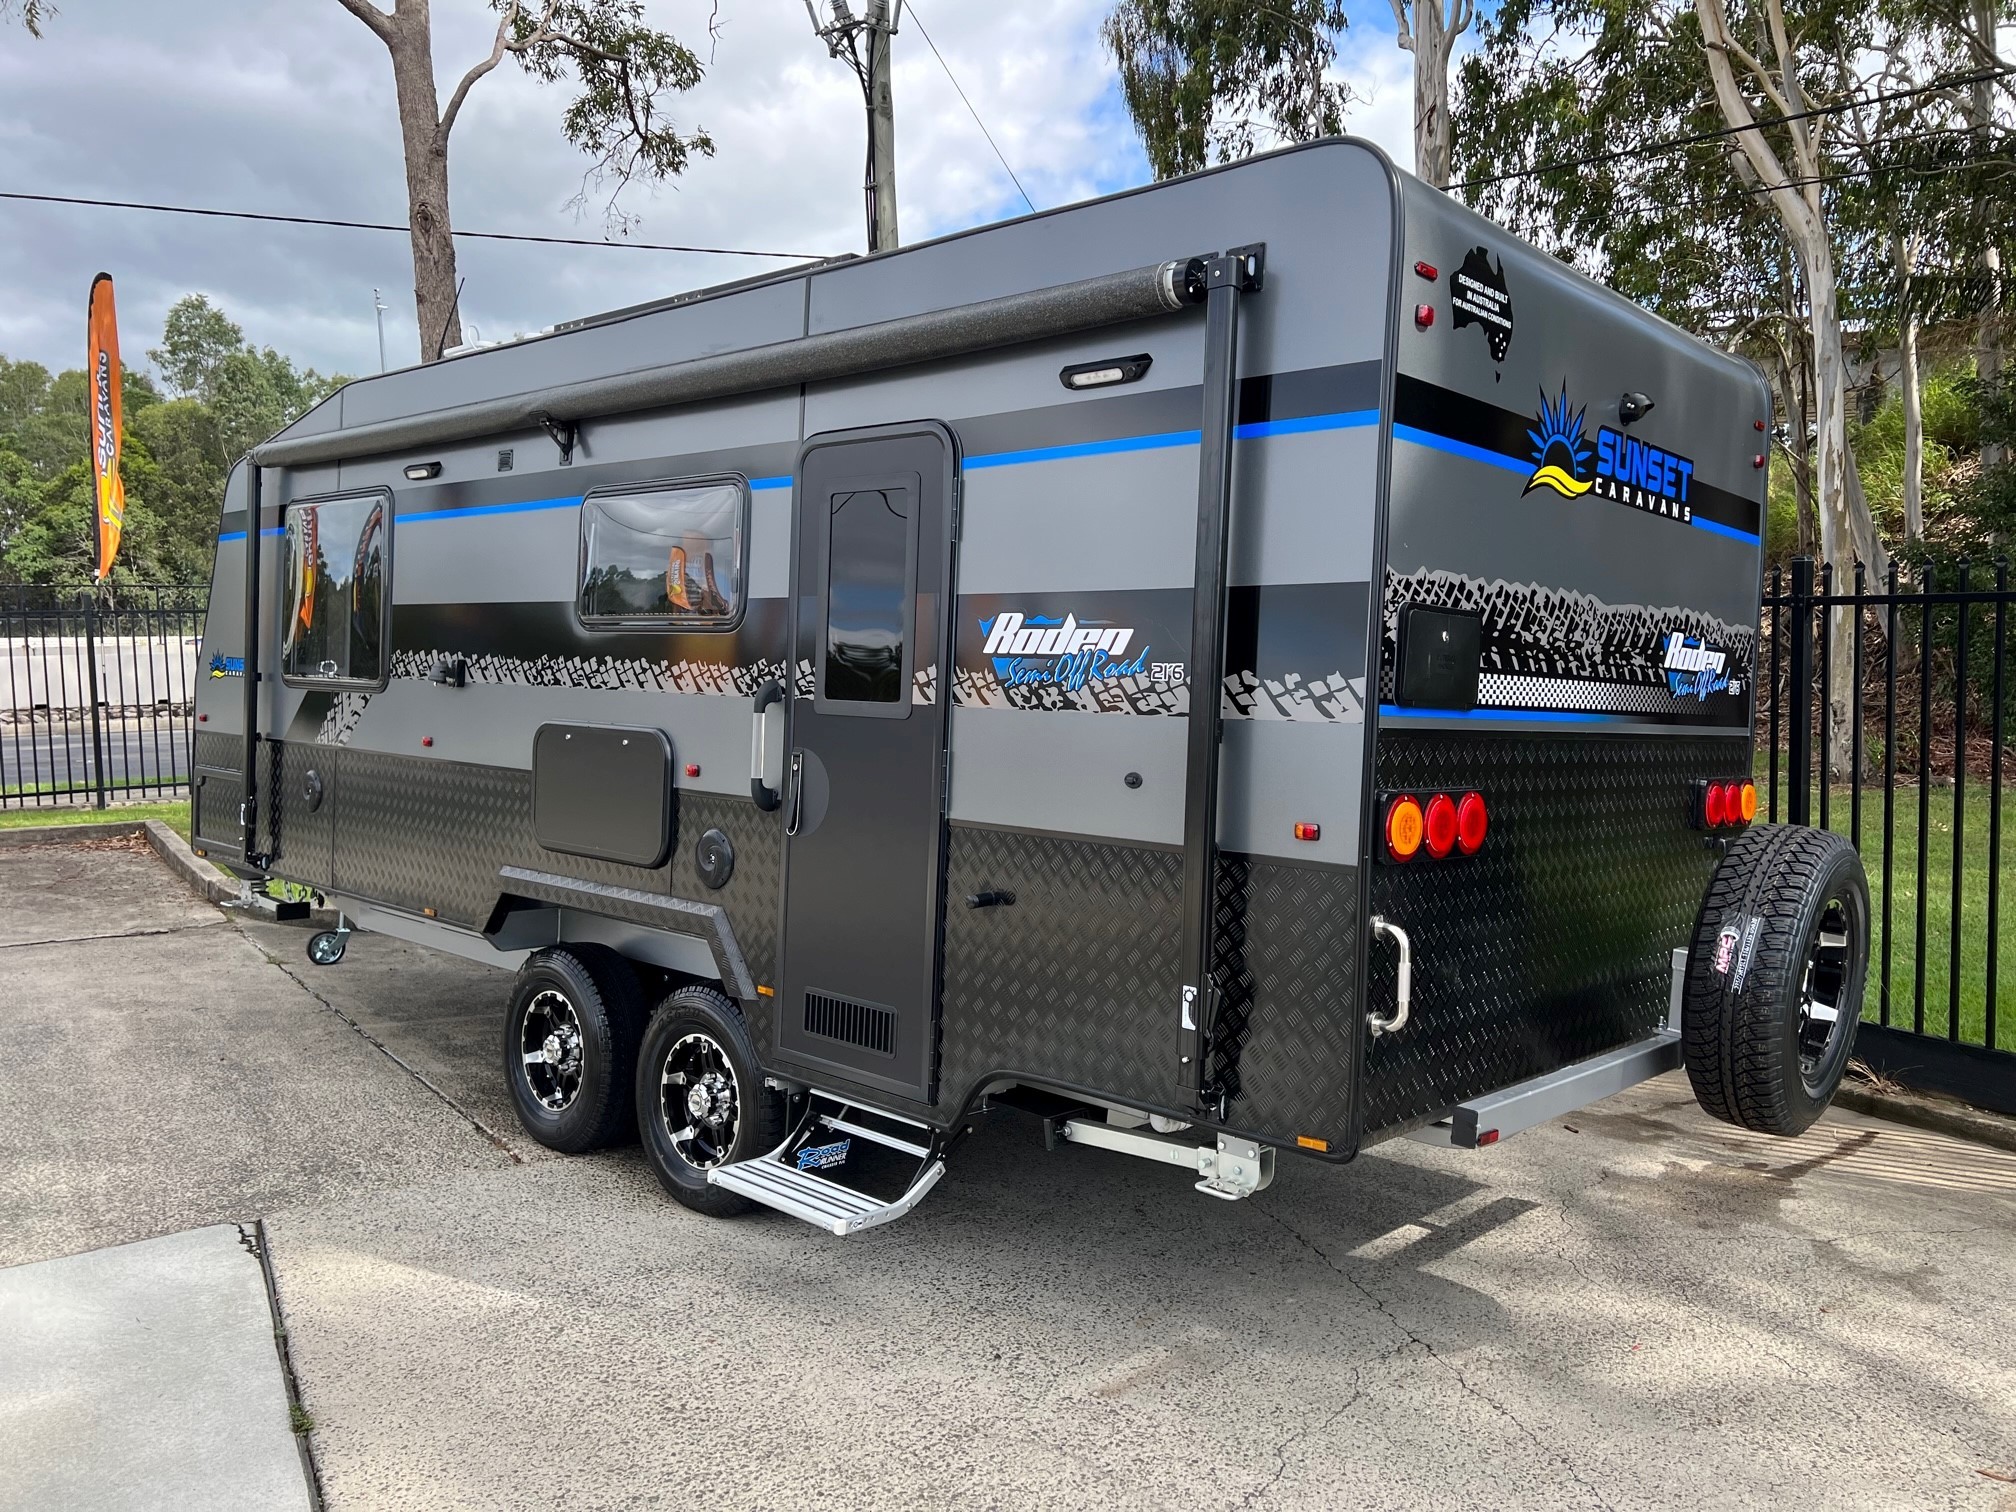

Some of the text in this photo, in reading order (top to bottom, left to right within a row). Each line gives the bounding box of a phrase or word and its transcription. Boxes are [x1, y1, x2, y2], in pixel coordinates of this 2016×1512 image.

[1458, 273, 1508, 304] DESIGNED AND BUILT
[1466, 290, 1500, 313] IN AUSTRALIA
[1452, 296, 1512, 329] FOR AUSTRALIAN CONDITIONS
[1597, 428, 1693, 502] SUNSET
[1595, 477, 1691, 522] CARAVANS
[982, 611, 1135, 656] Rodeo
[1004, 645, 1151, 692] Semi Off Road
[1663, 631, 1726, 674] Rodeo
[1672, 671, 1695, 699] Semi
[1707, 666, 1731, 694] Road
[797, 1138, 851, 1170] Road
[820, 1152, 847, 1165] RUNNER
